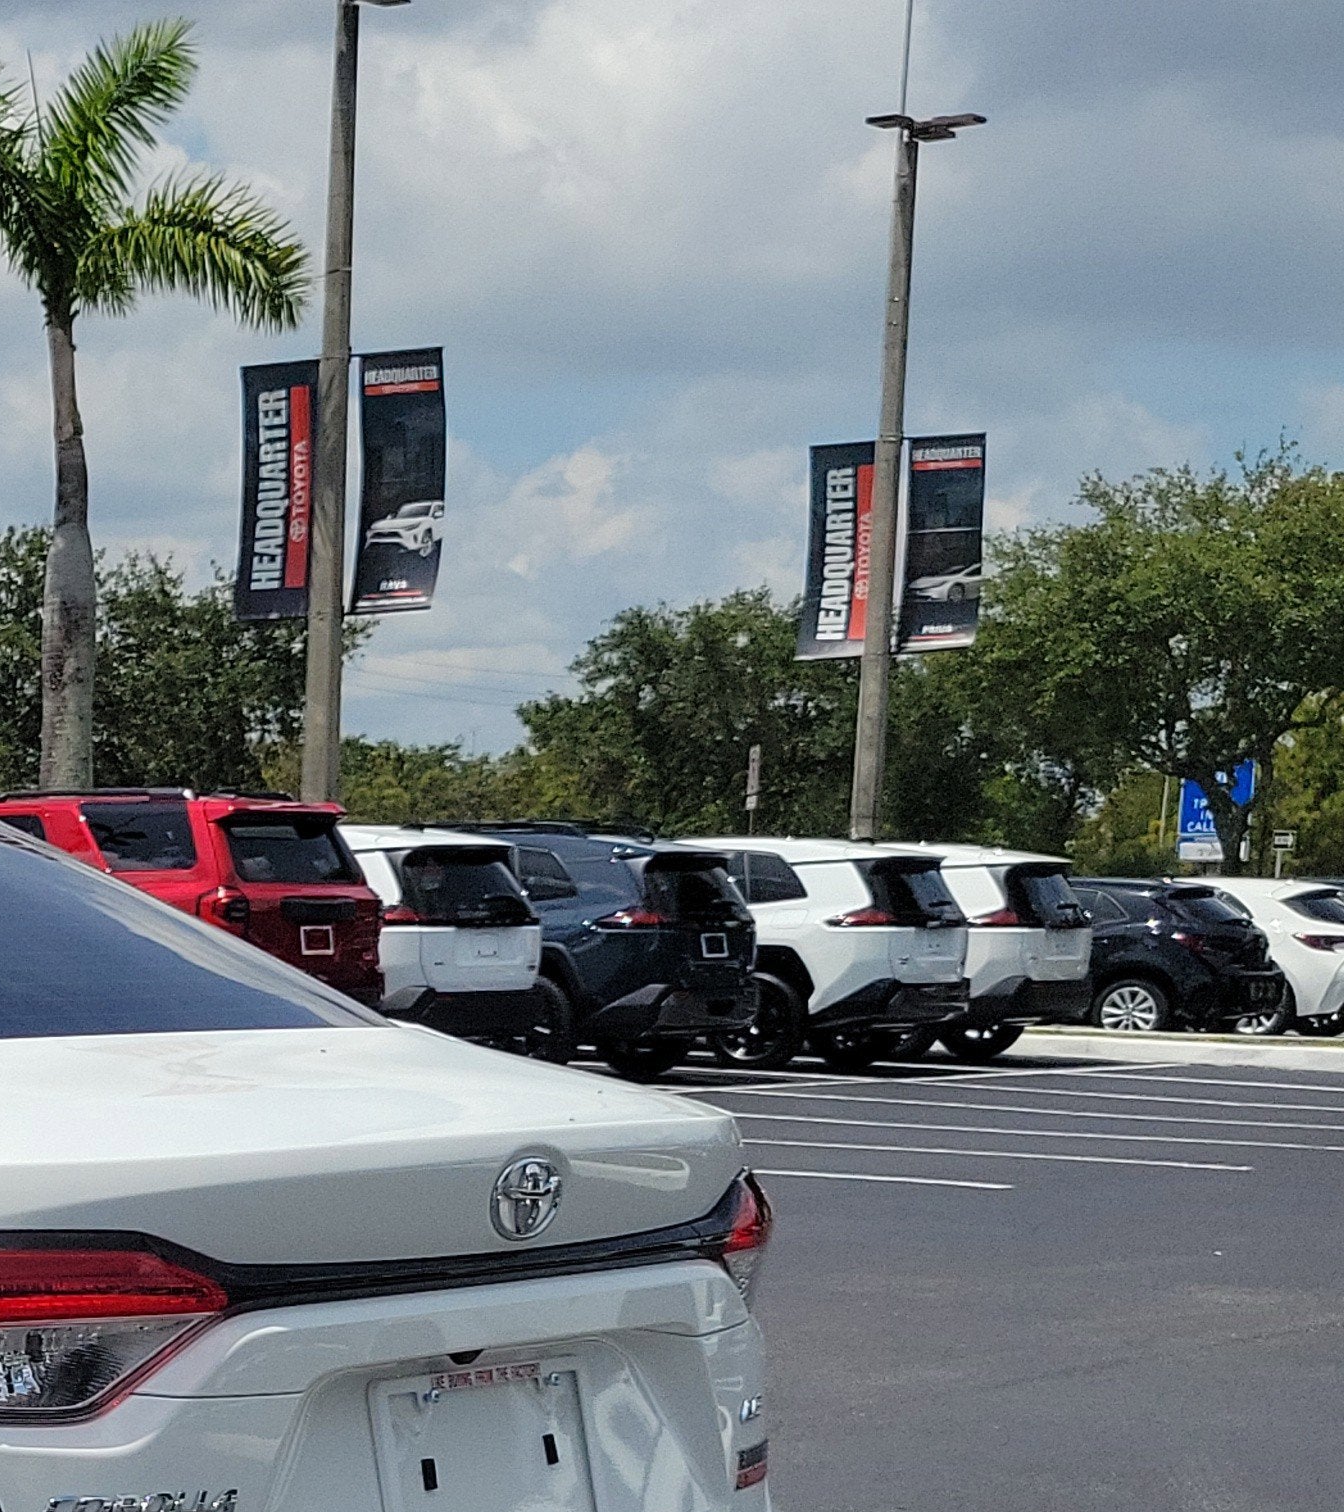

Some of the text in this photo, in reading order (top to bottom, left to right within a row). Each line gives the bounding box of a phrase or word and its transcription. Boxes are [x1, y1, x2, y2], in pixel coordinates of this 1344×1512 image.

[249, 388, 289, 591] HEADQUARTER
[292, 440, 310, 516] TOYOTA
[815, 466, 855, 641] HEADQUARTER
[857, 511, 873, 576] TOYOTA
[1187, 822, 1216, 832] CALL
